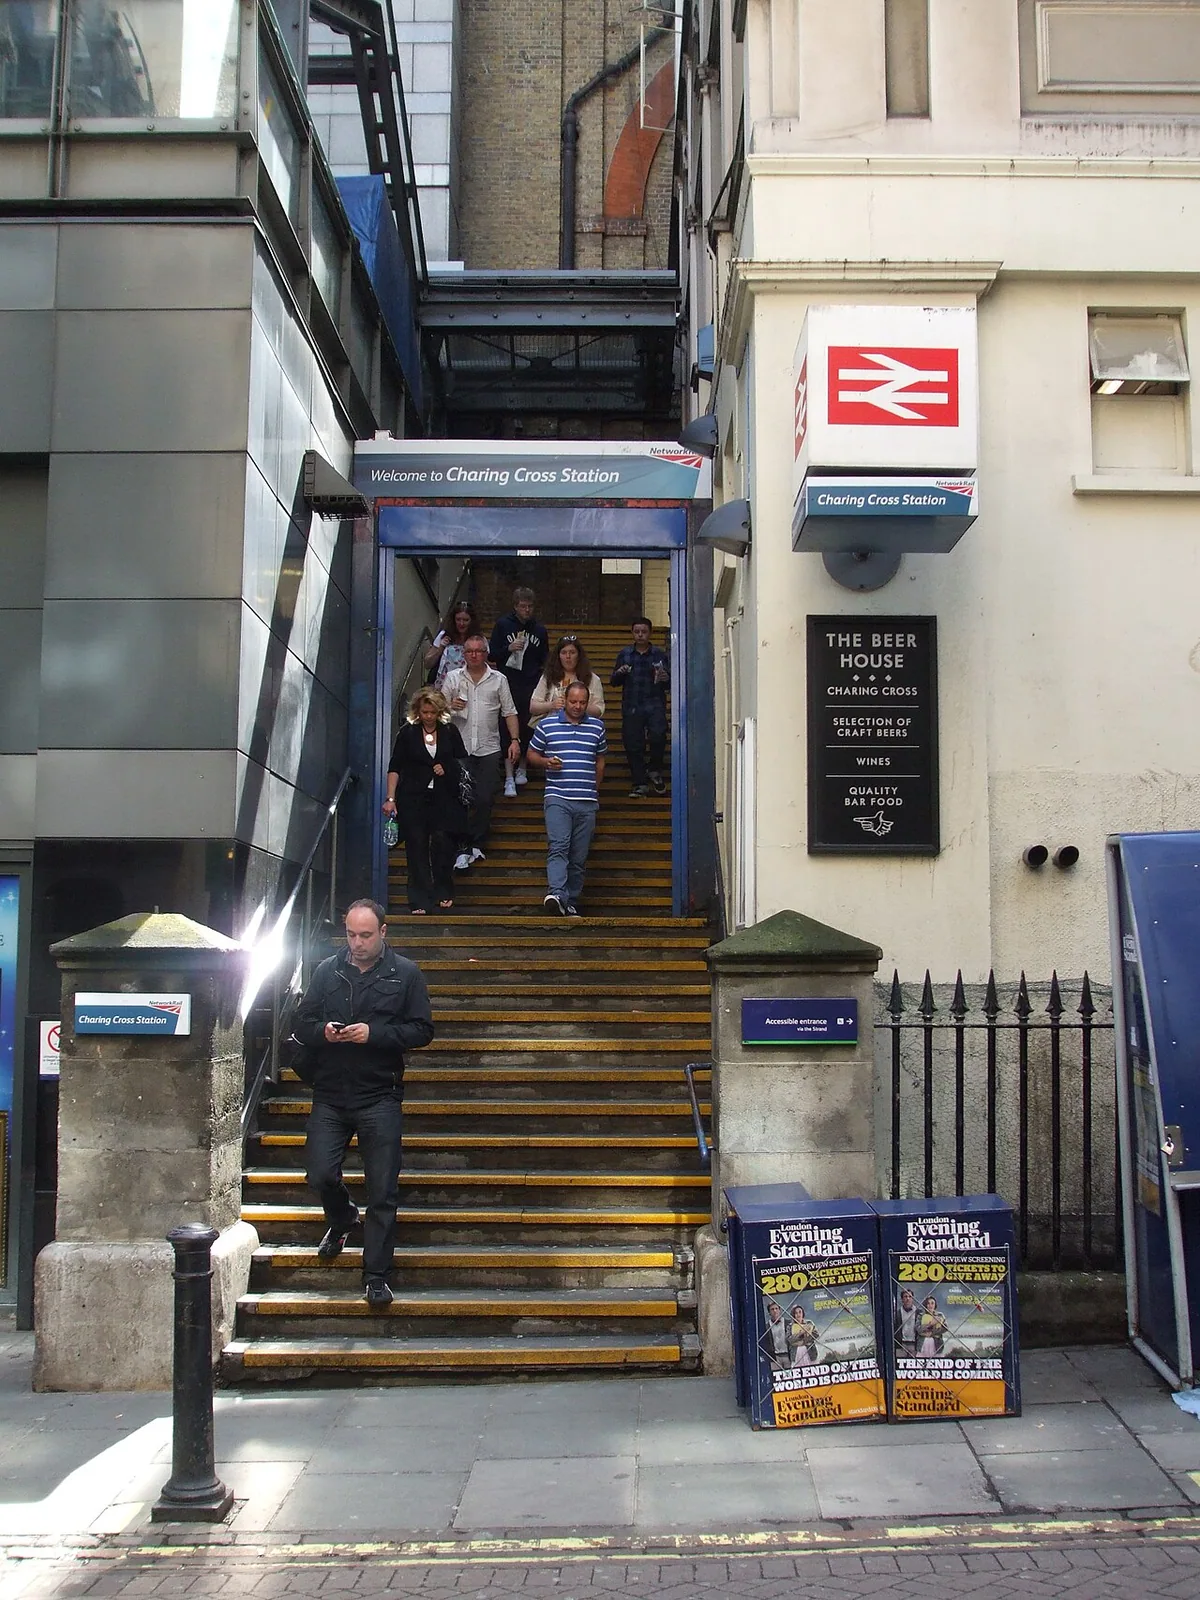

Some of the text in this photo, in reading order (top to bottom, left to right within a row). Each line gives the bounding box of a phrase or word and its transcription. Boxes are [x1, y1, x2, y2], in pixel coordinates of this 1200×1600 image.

[371, 466, 620, 485] Welcome to Charing Cross Station
[817, 494, 946, 508] Charing Cross Station
[826, 633, 917, 648] THE BEER
[840, 653, 904, 668] HOUSE
[827, 686, 918, 696] CHARING CROSS
[833, 717, 912, 727] SELECTION OF
[837, 728, 908, 737] CRAFT BEERS
[856, 757, 891, 766] WINES
[849, 787, 898, 796] QUALITY
[844, 798, 903, 807] BAR FOOD
[78, 1015, 167, 1026] Charing Cross Station
[781, 1223, 812, 1231] London
[918, 1216, 949, 1224] London
[770, 1225, 843, 1244] Evening
[907, 1219, 980, 1237] Evening
[770, 1239, 853, 1258] Standard
[907, 1232, 990, 1252] Standard
[760, 1255, 866, 1276] EXCLUSIVE PREVIEW SCREENING
[809, 1264, 868, 1279] TICKETS TO
[899, 1263, 945, 1281] 280
[946, 1264, 1006, 1272] TICKETS TO
[762, 1272, 807, 1294] 280
[809, 1272, 868, 1287] GIVE AWAY
[945, 1273, 1004, 1281] GIVE AWAY
[773, 1358, 877, 1381] THE END OF THE
[897, 1359, 1002, 1369] THE END OF THE
[773, 1369, 880, 1392] WORLD IS COMING
[896, 1370, 1003, 1379] WORLD IS COMING
[785, 1394, 809, 1402] London
[896, 1388, 954, 1401] Evening
[777, 1395, 833, 1412] Evening
[896, 1400, 960, 1412] Standard
[778, 1404, 842, 1425] Standard
